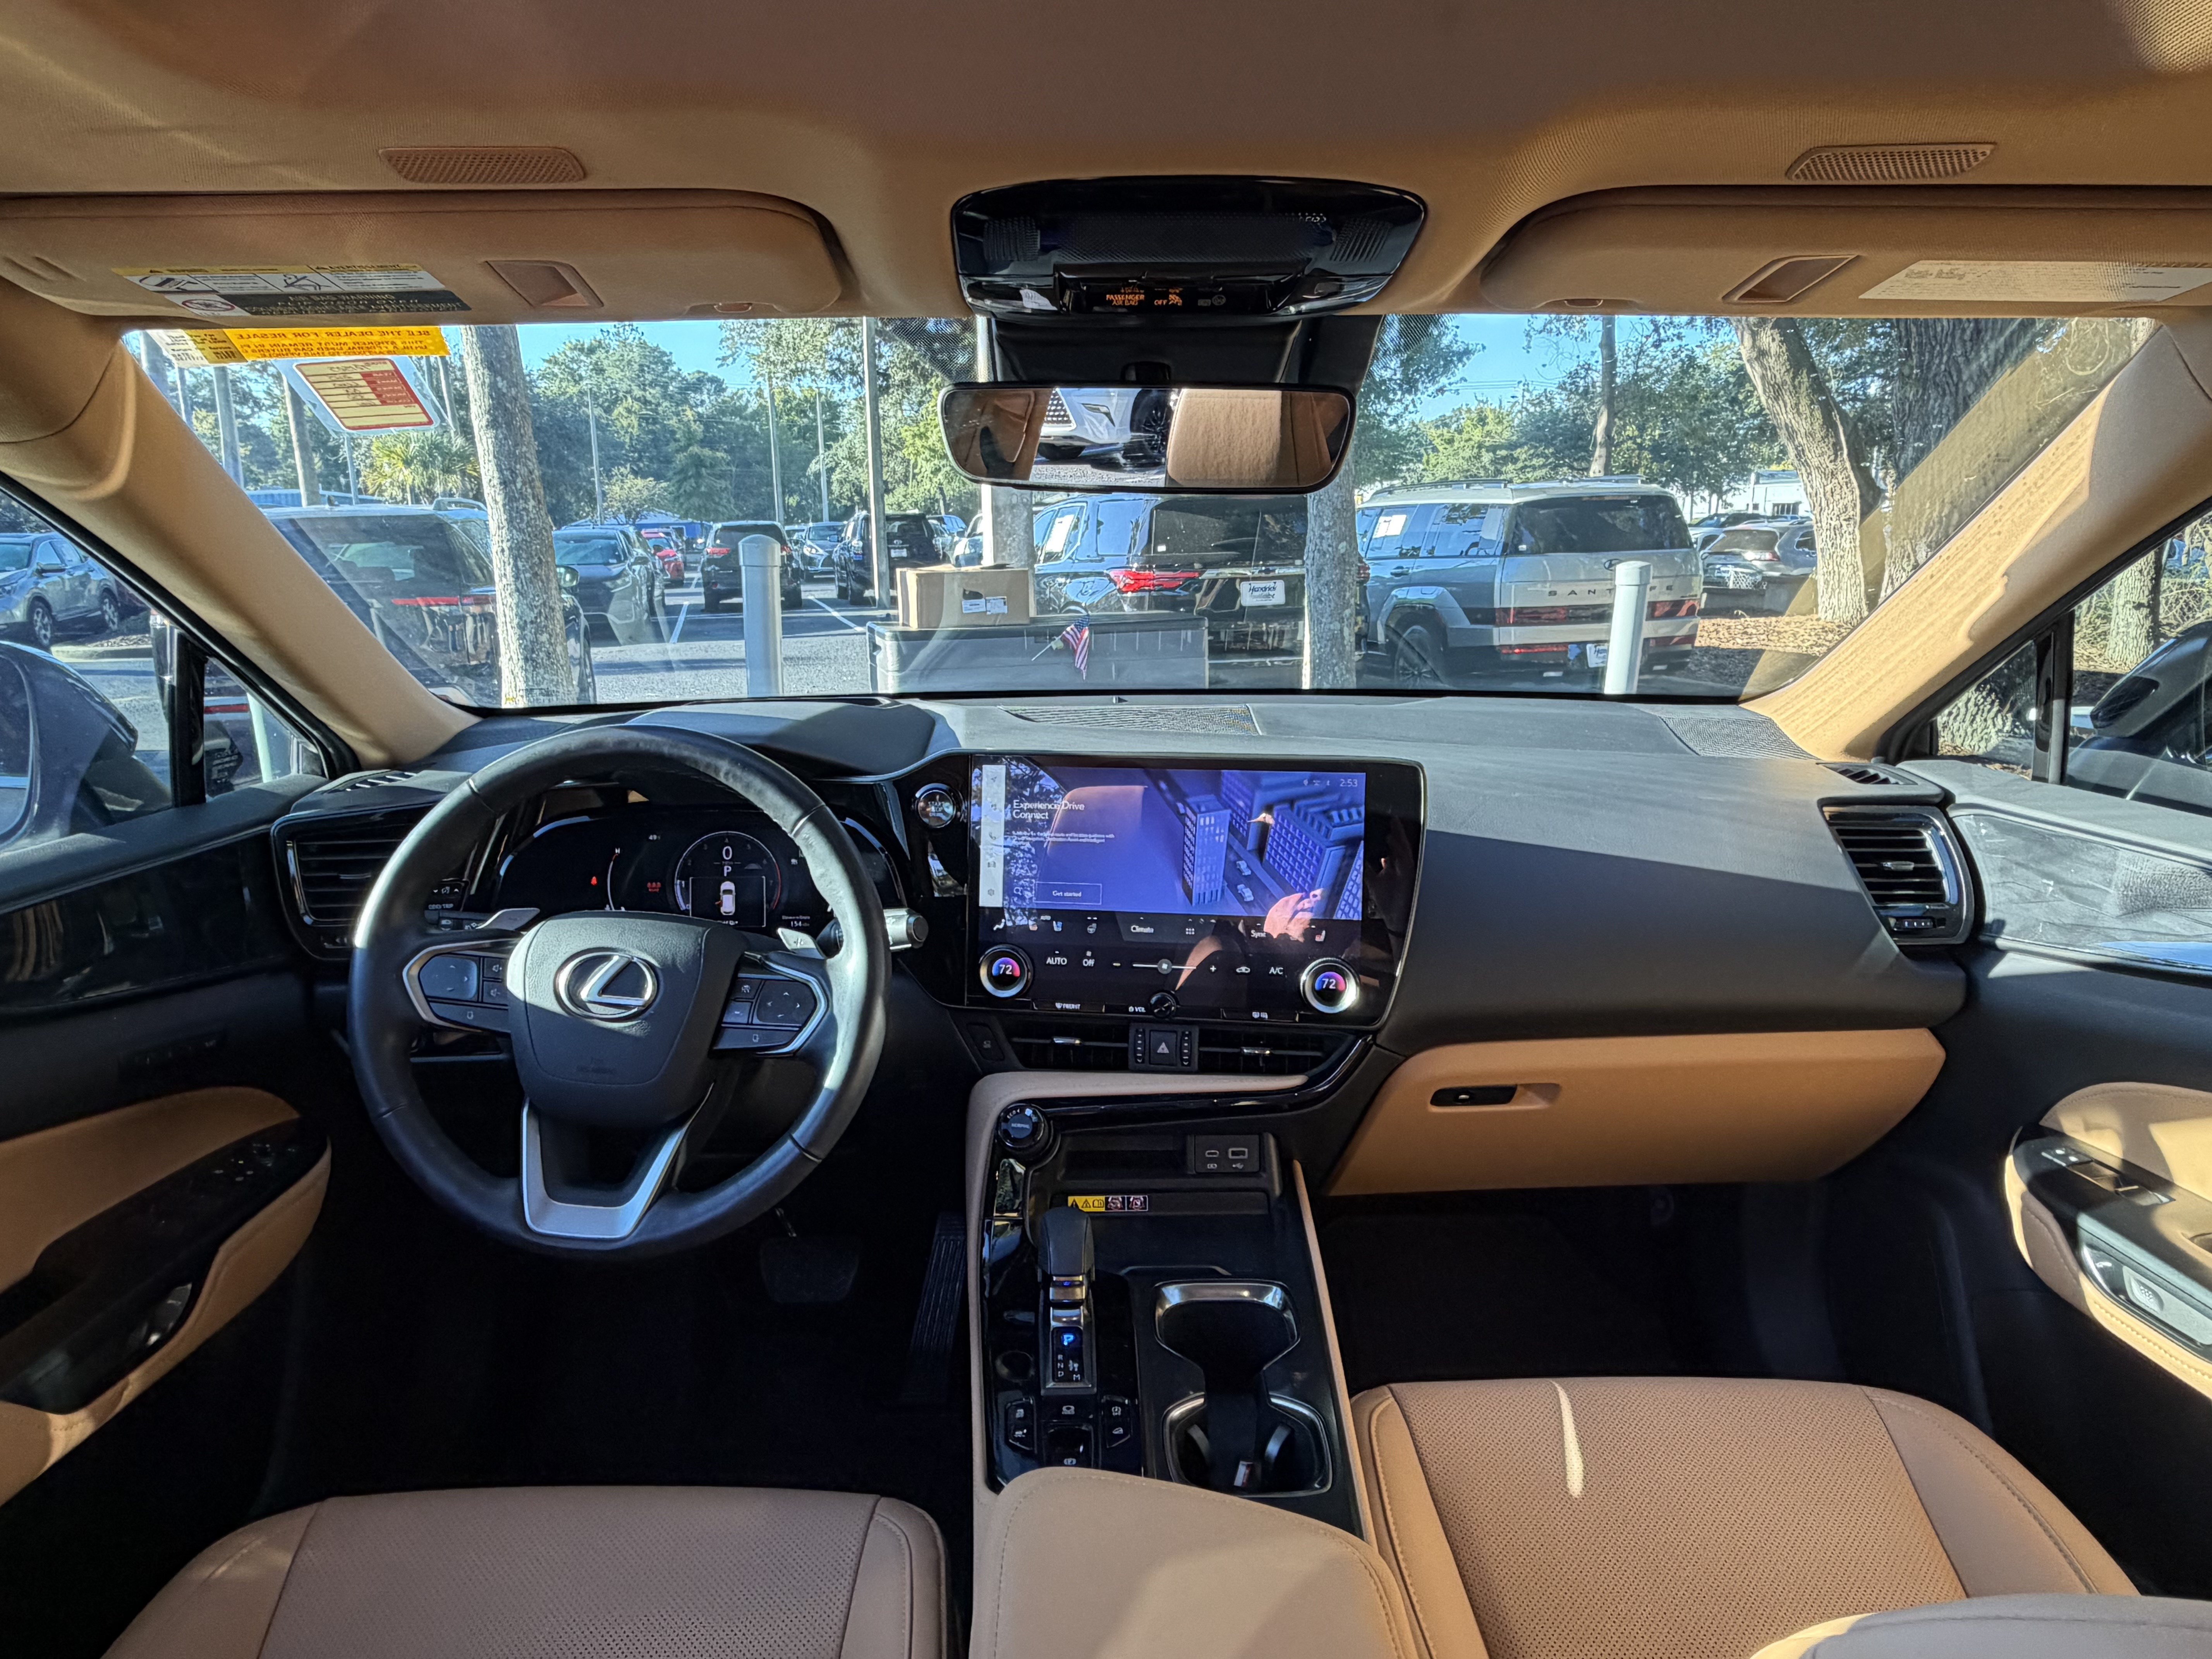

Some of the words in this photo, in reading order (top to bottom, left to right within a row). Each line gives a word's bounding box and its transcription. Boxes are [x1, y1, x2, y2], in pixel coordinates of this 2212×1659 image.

[1548, 588, 1614, 597] SANT
[1340, 778, 1358, 787] 2:53
[1013, 799, 1061, 810] Experience
[1062, 801, 1085, 811] Drive
[1012, 810, 1049, 819] Connect
[722, 846, 732, 860] 0
[724, 866, 732, 877] P
[1131, 925, 1154, 934] Climate
[1251, 930, 1266, 938] Sync
[1083, 959, 1095, 967] Off
[999, 964, 1012, 974] 72
[1269, 967, 1284, 975] A/C
[1322, 978, 1336, 989] 72
[1063, 1334, 1074, 1345] P
